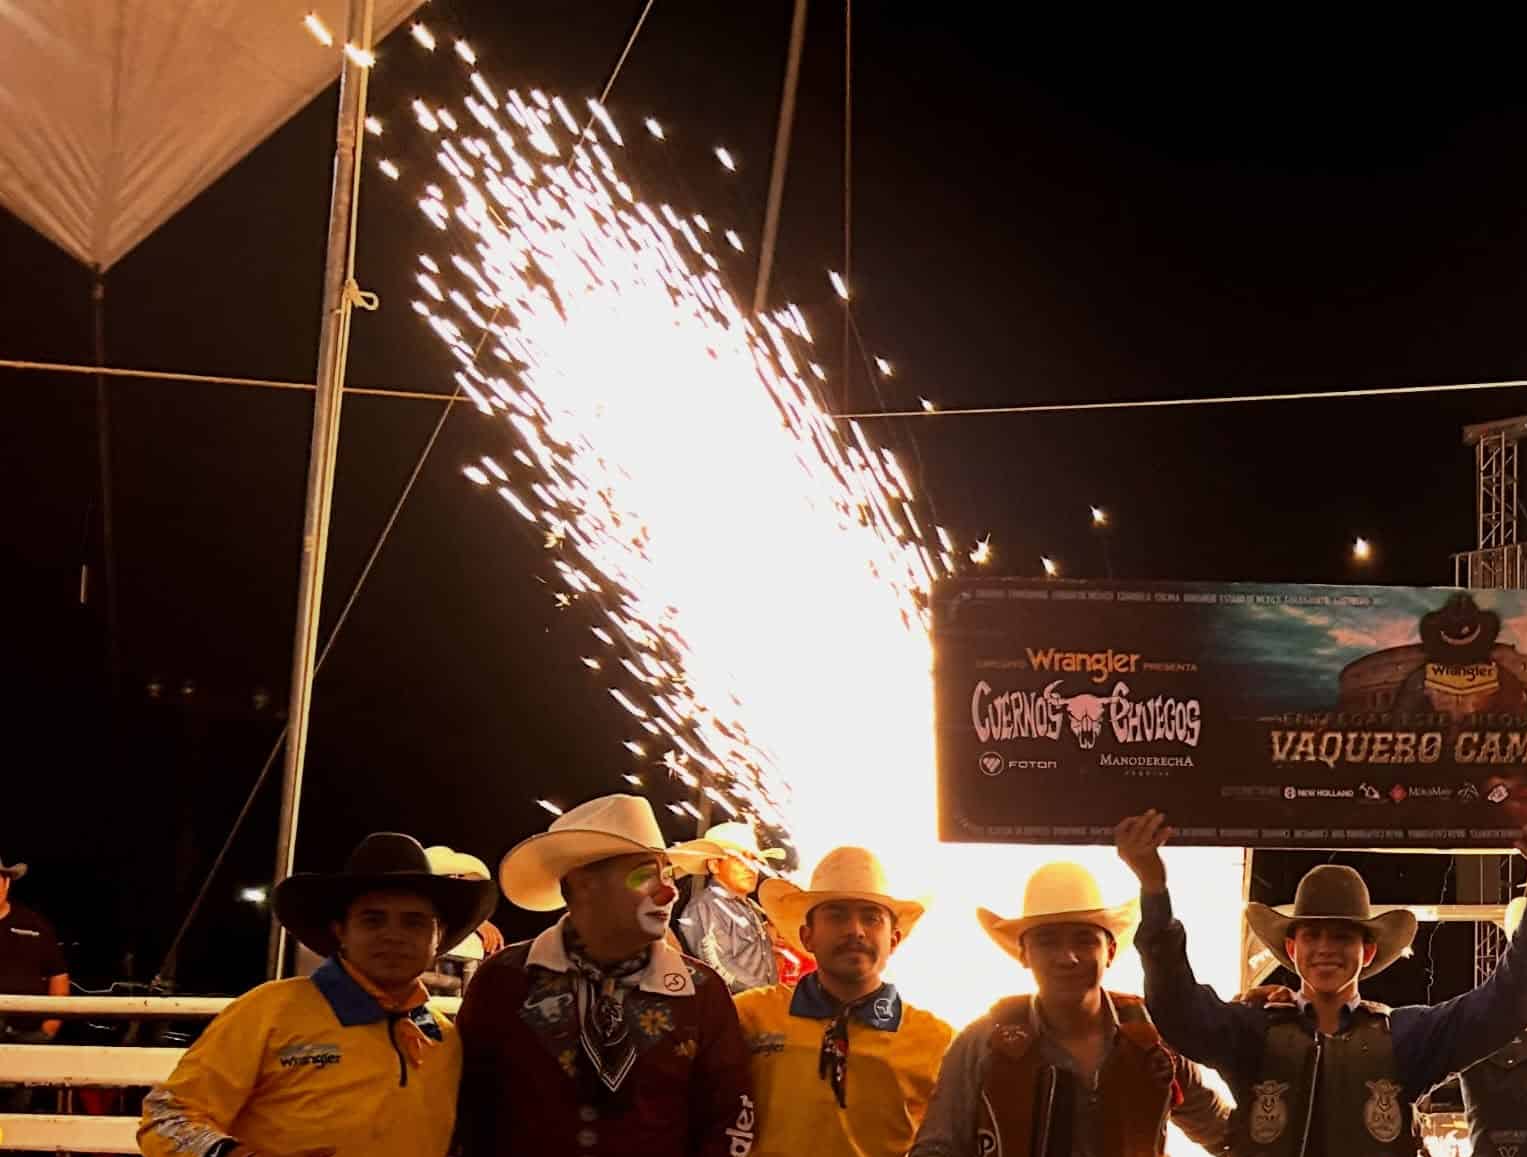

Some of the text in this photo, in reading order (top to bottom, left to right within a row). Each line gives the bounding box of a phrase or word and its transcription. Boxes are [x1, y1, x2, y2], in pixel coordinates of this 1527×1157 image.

[1025, 647, 1141, 684] Wrangler
[1432, 663, 1493, 682] Wrangler
[971, 680, 1201, 747] CUERNOS CHUECOS
[1270, 729, 1442, 768] VAQUERO
[1008, 759, 1057, 769] FOTON
[1099, 753, 1194, 768] MANODERECHA
[1317, 788, 1355, 798] HOLLAND
